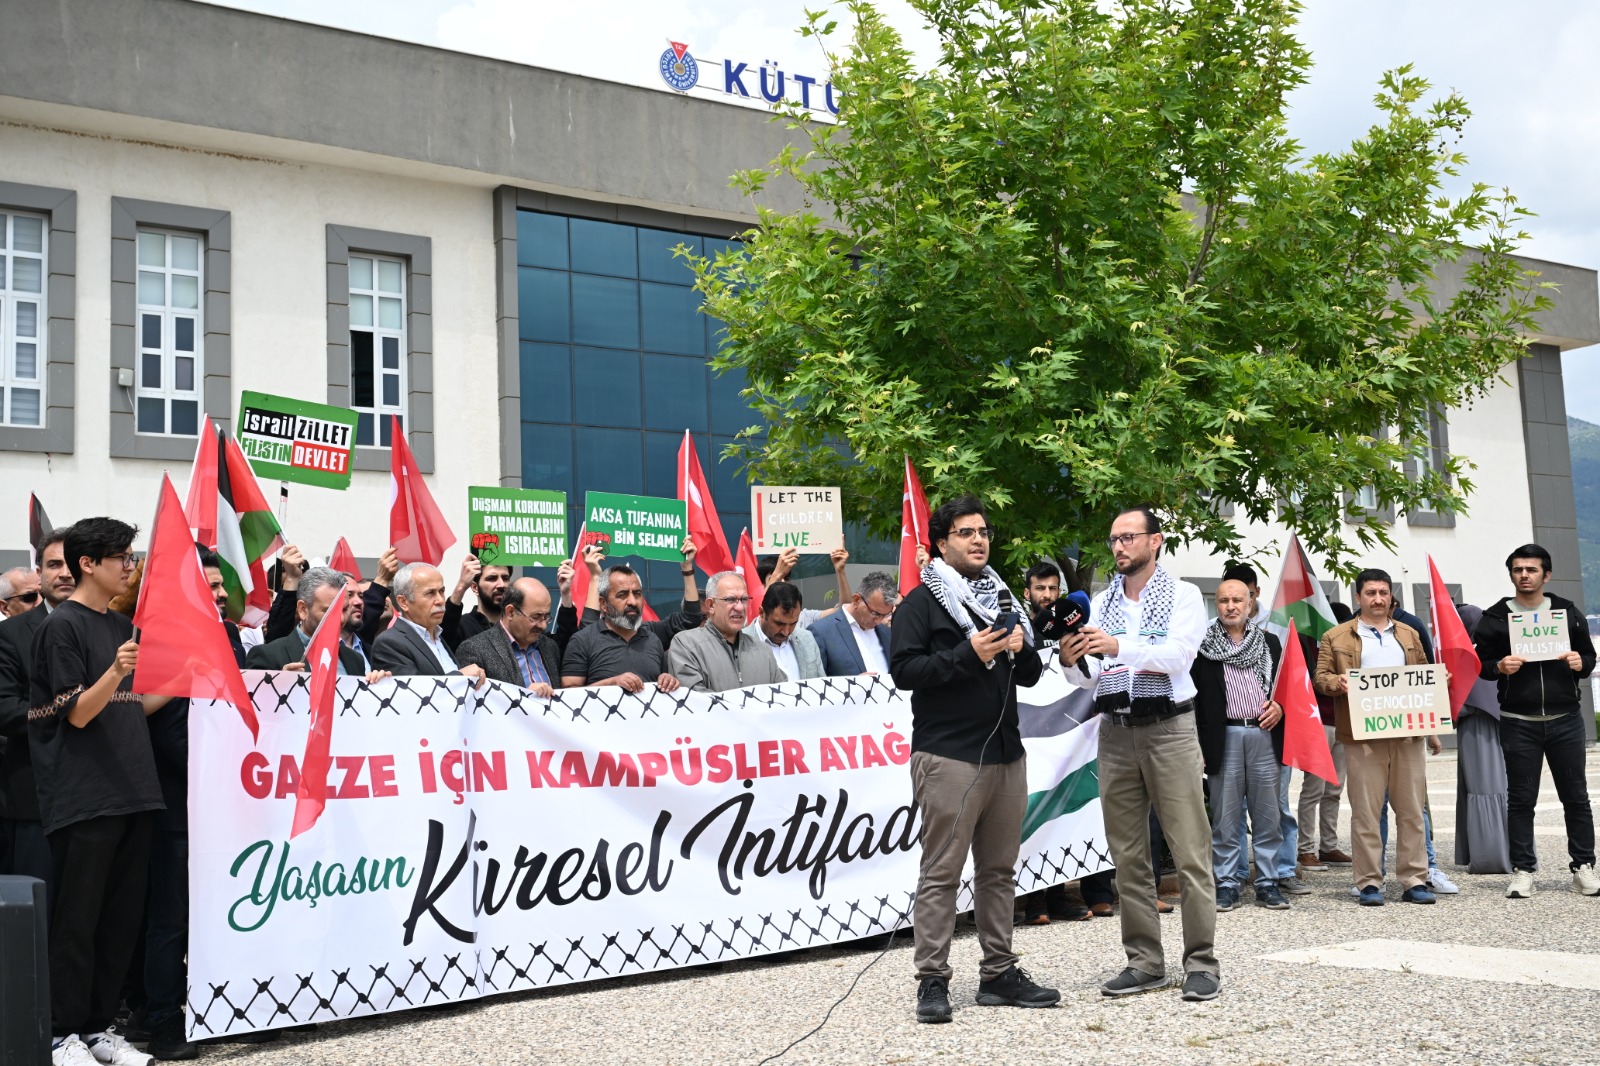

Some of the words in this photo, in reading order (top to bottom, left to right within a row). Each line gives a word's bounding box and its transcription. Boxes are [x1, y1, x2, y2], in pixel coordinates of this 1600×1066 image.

[243, 410, 294, 437] israil
[294, 445, 347, 472] DEVLET
[514, 499, 564, 515] KORKUDAN
[769, 491, 797, 504] LET
[804, 491, 832, 503] THE
[483, 515, 565, 534] PARMAKLARINI
[590, 507, 623, 525] AKSA
[626, 510, 682, 530] TUFANINA
[768, 511, 833, 525] CHILDREN
[505, 535, 565, 556] ISIRACAK
[614, 527, 635, 545] BİN
[638, 532, 678, 549] SELAM!
[1063, 609, 1078, 623] TRT
[1533, 613, 1539, 623] I
[1521, 626, 1559, 638] LOVE
[1515, 640, 1570, 655] PALISTINE
[1359, 672, 1399, 691] STOP
[1404, 670, 1436, 686] THE
[1361, 692, 1434, 712] GENOCIDE
[240, 751, 399, 800] GAZE
[526, 736, 810, 789] KAMPÜSLER
[227, 839, 415, 933] Yaşasın
[402, 808, 674, 947] Küresel
[680, 778, 922, 900] İntifad
